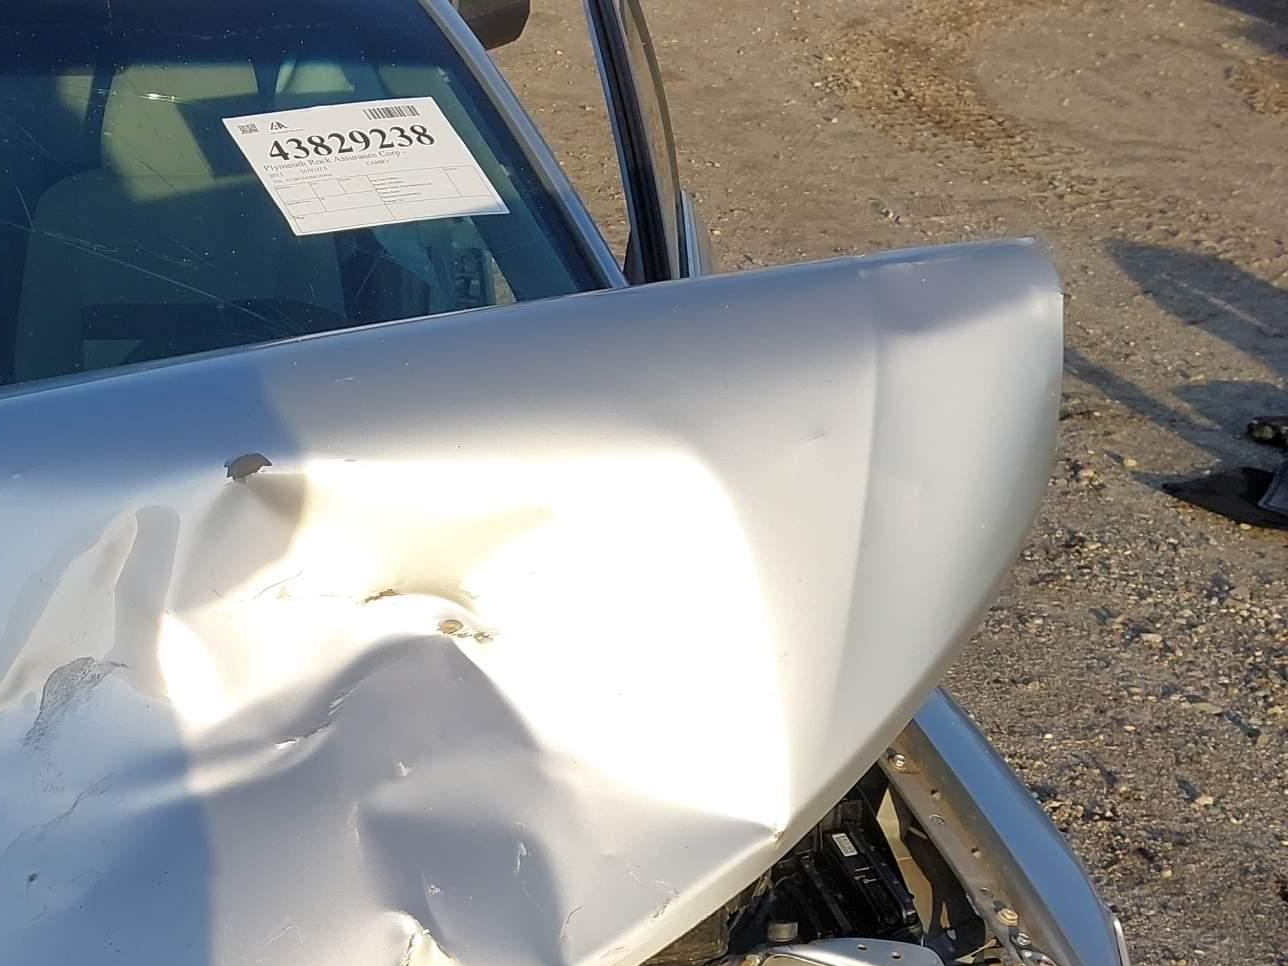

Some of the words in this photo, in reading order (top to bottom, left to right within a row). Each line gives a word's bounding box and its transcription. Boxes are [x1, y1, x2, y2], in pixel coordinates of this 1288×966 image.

[269, 124, 435, 161] 43829238
[264, 160, 306, 172] Plymouth
[308, 156, 333, 166] Rock
[334, 152, 377, 163] Assurance
[379, 149, 400, 158] Corp
